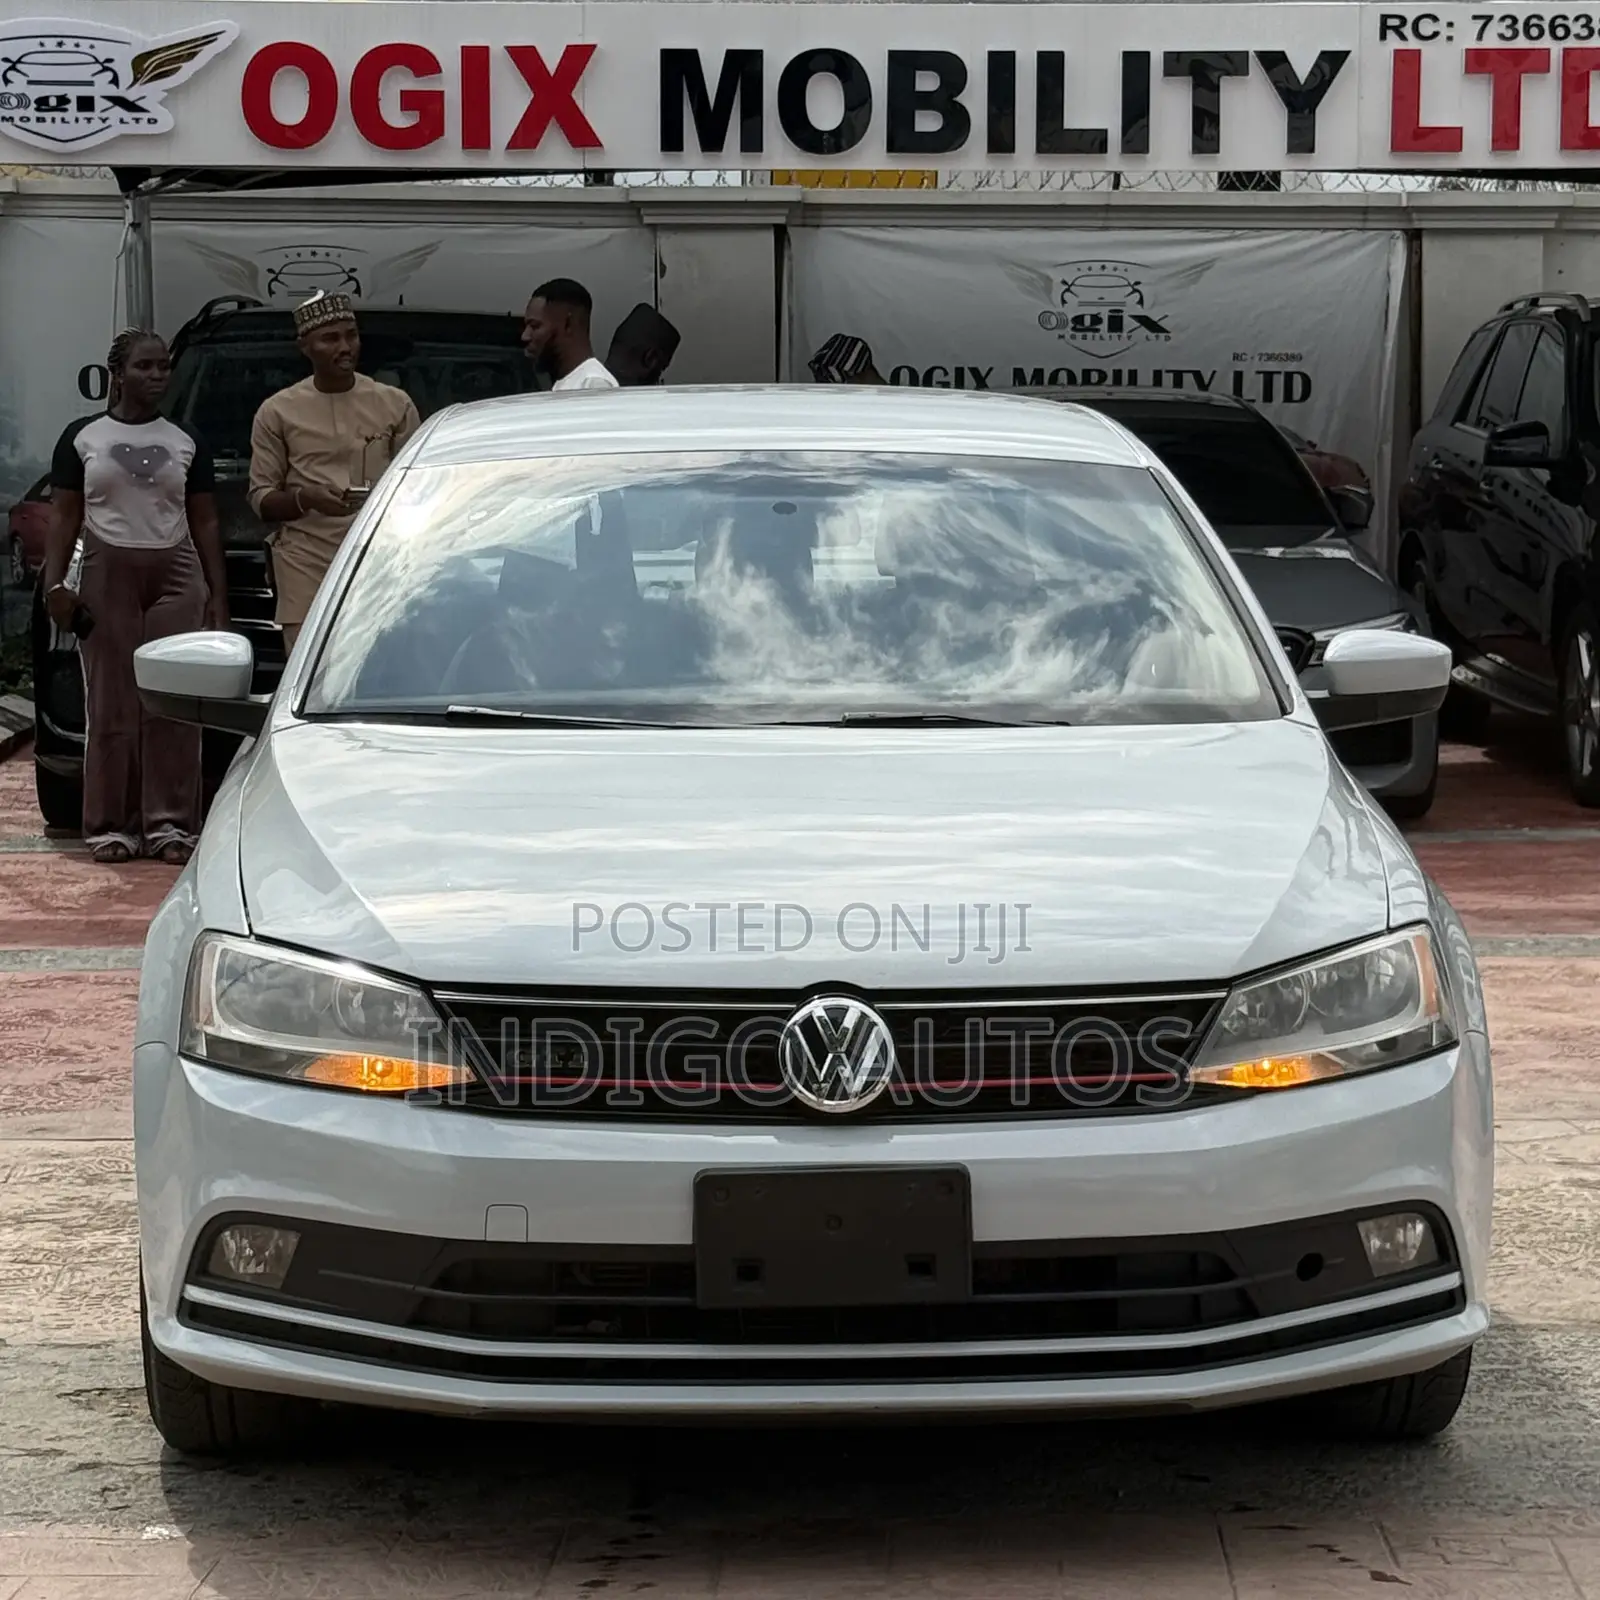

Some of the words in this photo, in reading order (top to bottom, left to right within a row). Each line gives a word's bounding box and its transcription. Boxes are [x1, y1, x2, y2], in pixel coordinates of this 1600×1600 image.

[1379, 13, 1455, 42] RC:
[1471, 14, 1600, 42] 73663
[241, 41, 604, 151] OGIX
[659, 47, 1352, 155] MOBILITY
[0, 115, 109, 124] MOBILITY
[119, 117, 159, 125] LTD
[1232, 370, 1312, 403] LTD
